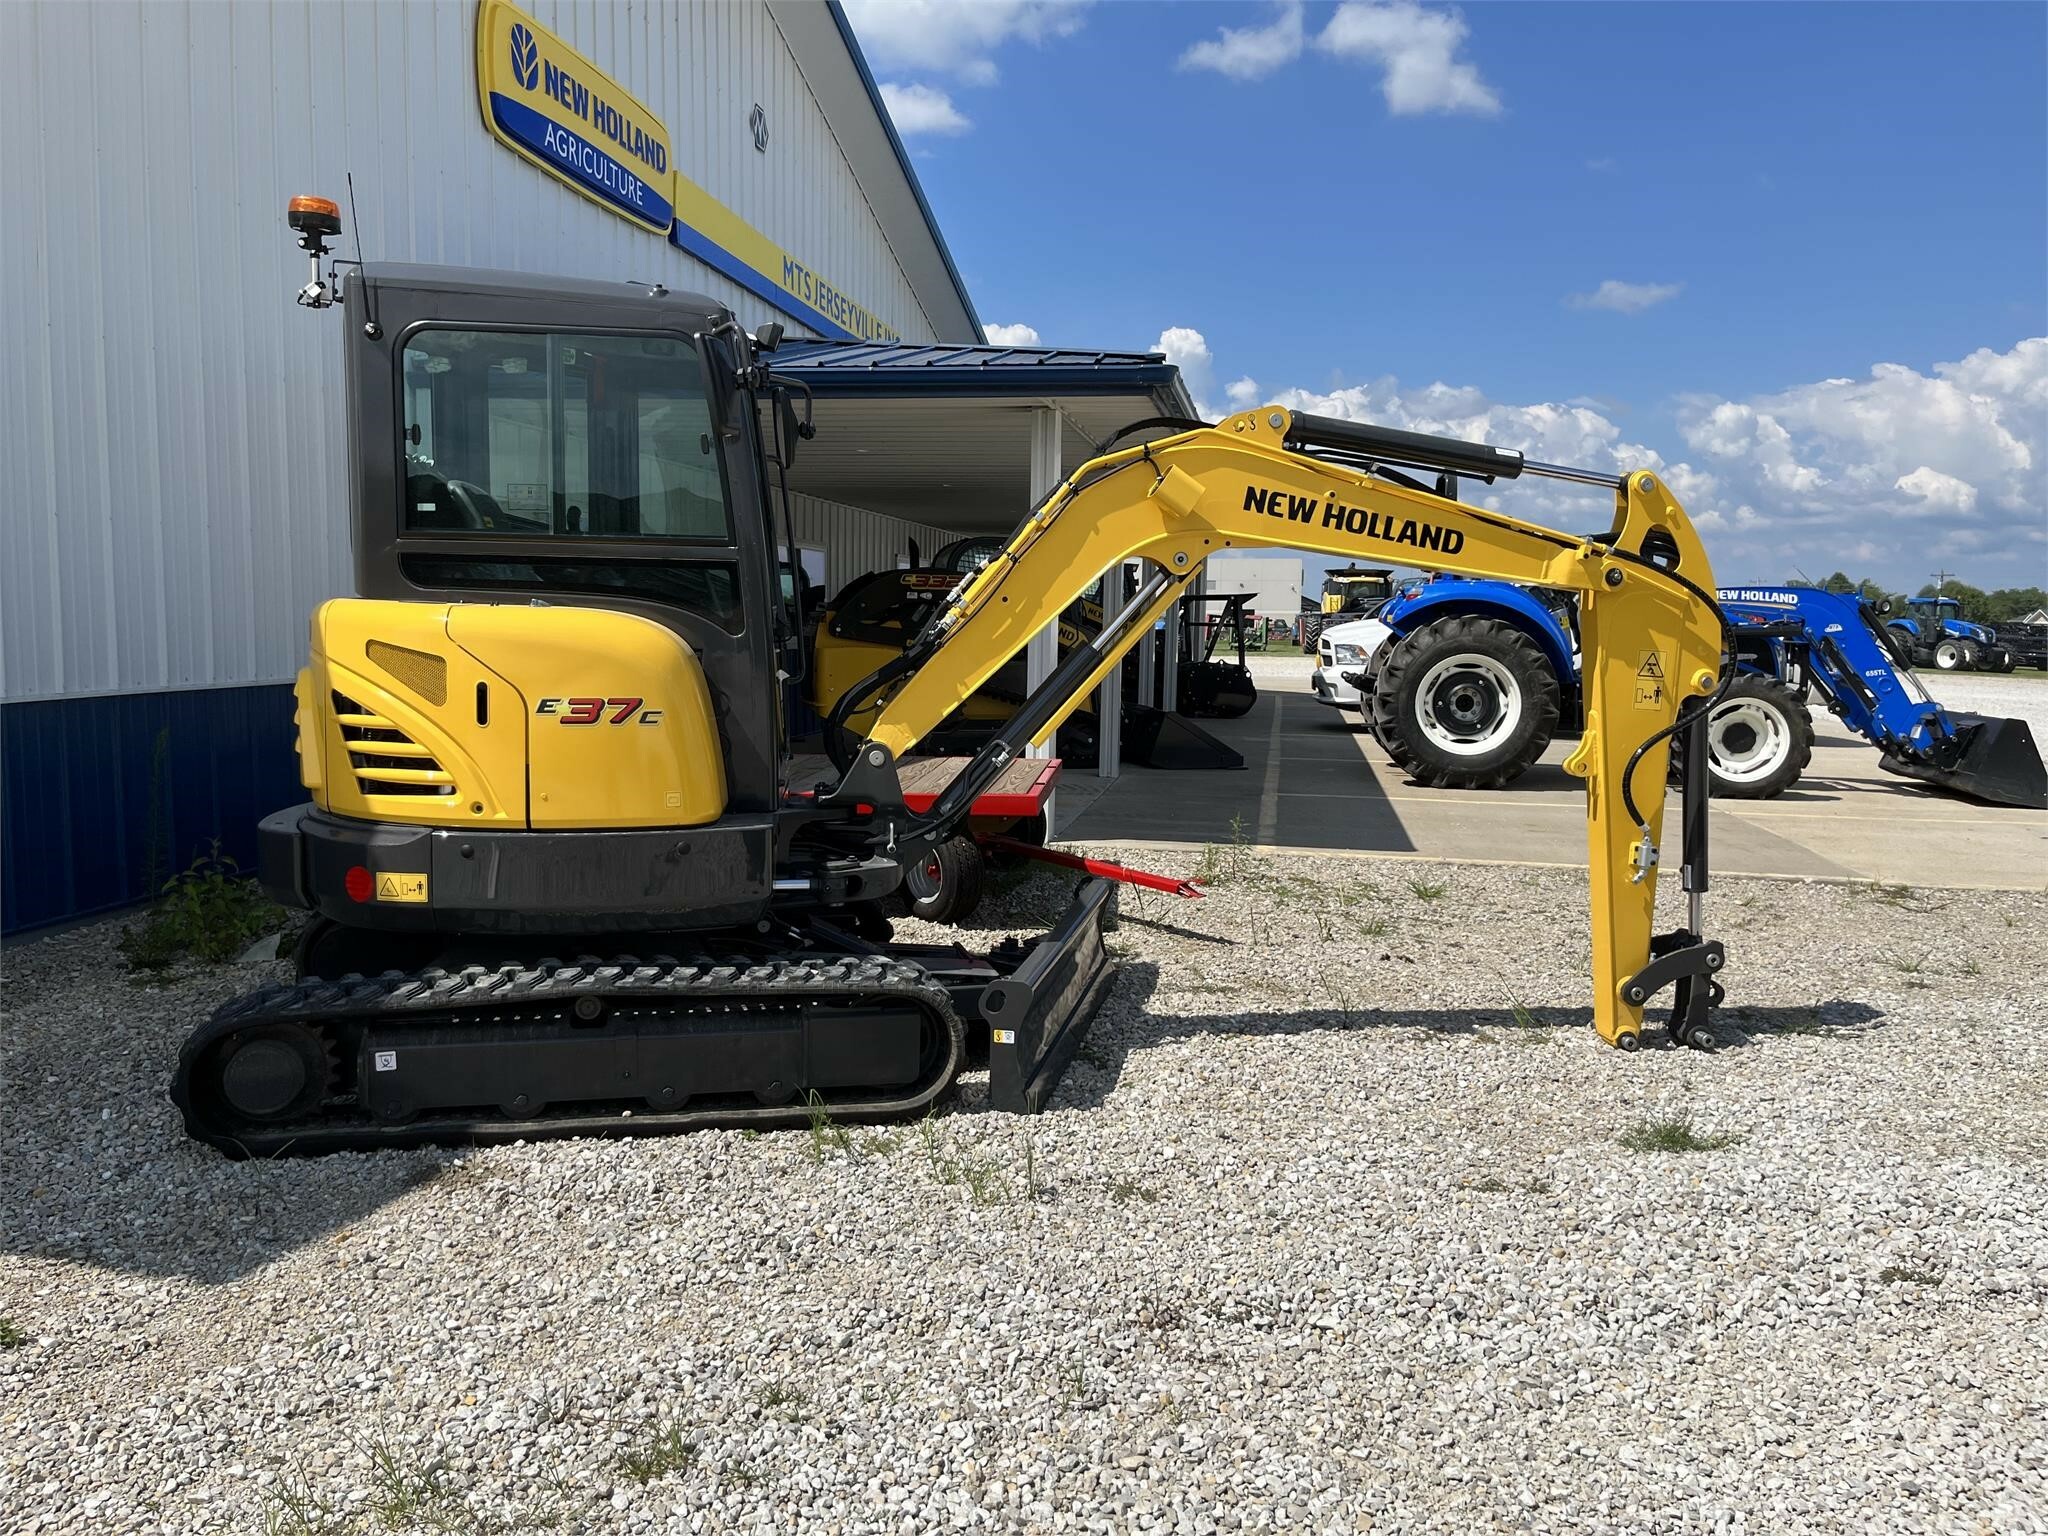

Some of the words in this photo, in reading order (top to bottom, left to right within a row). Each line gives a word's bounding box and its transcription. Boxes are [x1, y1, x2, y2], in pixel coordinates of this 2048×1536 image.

[544, 58, 590, 122] NEW
[593, 94, 667, 175] HOLLAND
[544, 122, 643, 206] AGRICULTURE
[783, 255, 812, 302] MTS
[1242, 485, 1318, 524] NEW
[1321, 503, 1465, 555] HOLLAND
[1741, 589, 1799, 605] HOLLAND
